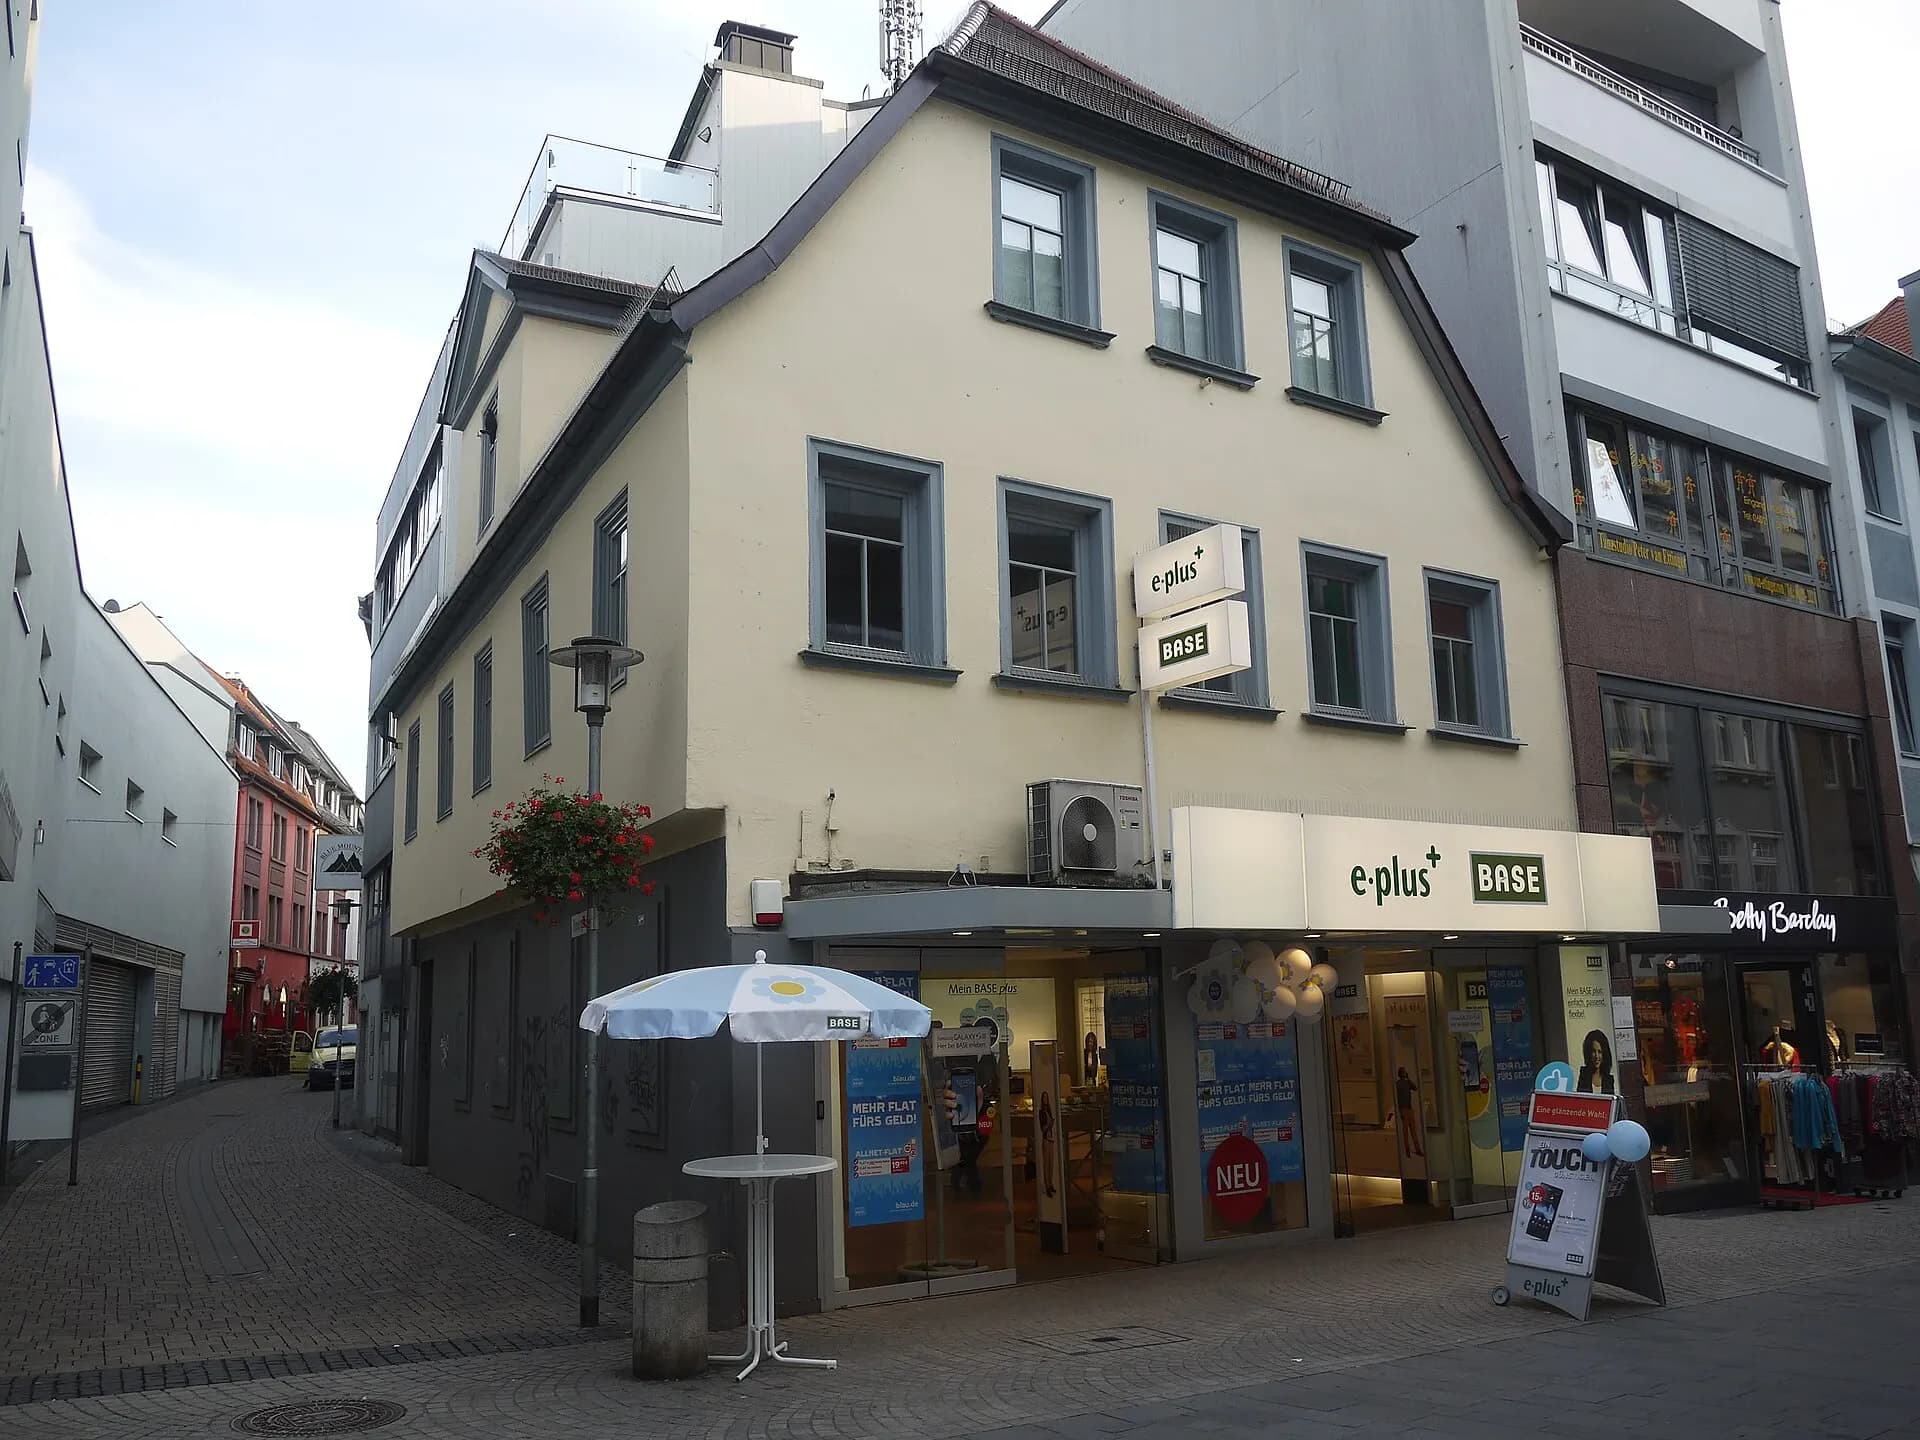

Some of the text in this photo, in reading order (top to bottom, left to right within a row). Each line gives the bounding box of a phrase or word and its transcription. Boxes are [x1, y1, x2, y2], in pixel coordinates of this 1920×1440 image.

[1162, 632, 1205, 661] BASE
[1477, 862, 1541, 895] BASE
[1768, 900, 1836, 942] Barclay
[948, 984, 972, 994] Mein
[974, 984, 997, 994] BASE
[829, 1018, 859, 1028] BASE
[1224, 1083, 1246, 1094] FLAT
[1274, 1080, 1295, 1089] FLAT
[852, 1100, 917, 1114] MEHR FLAT
[852, 1112, 917, 1127] FÜRS GELD!
[1216, 1162, 1260, 1191] NEU
